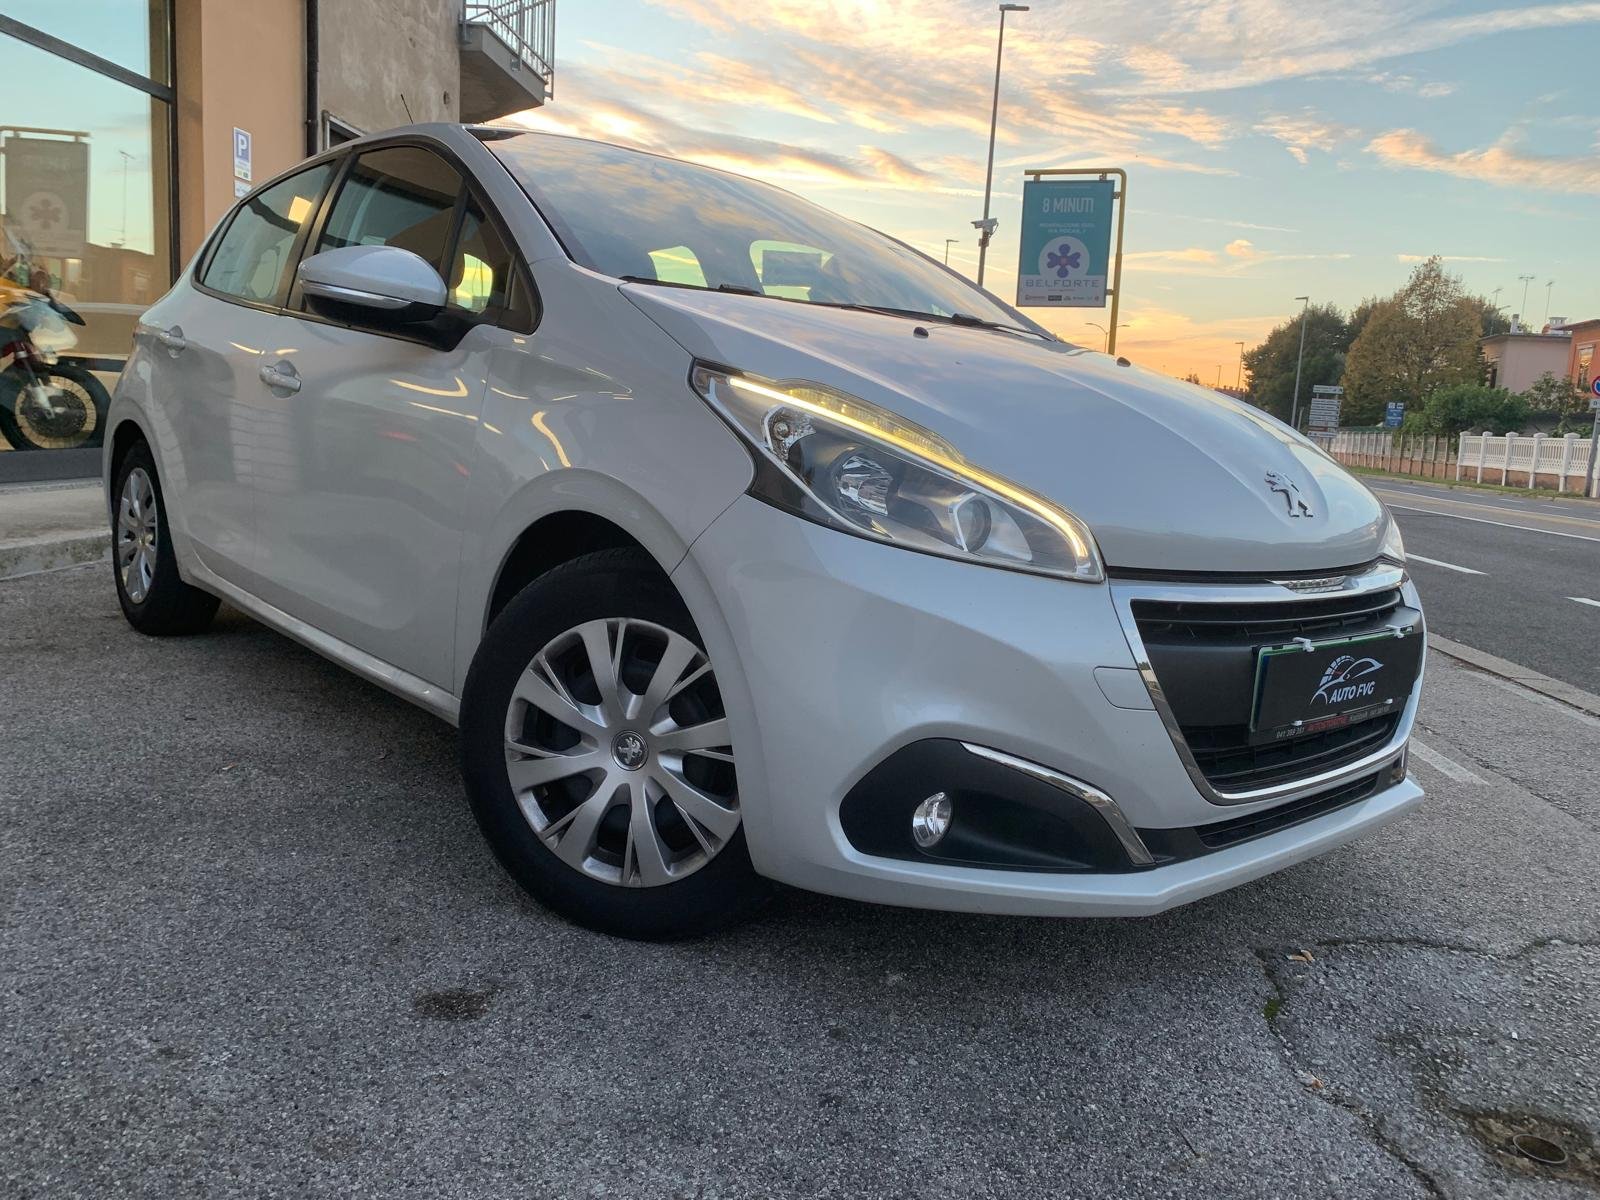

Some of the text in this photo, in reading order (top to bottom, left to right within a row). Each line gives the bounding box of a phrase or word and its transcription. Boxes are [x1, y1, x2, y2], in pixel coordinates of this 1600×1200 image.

[237, 134, 248, 156] P
[1042, 197, 1095, 213] 8 MINUTI
[1025, 279, 1100, 288] BELFORTE
[1329, 680, 1376, 703] AUTO FVG
